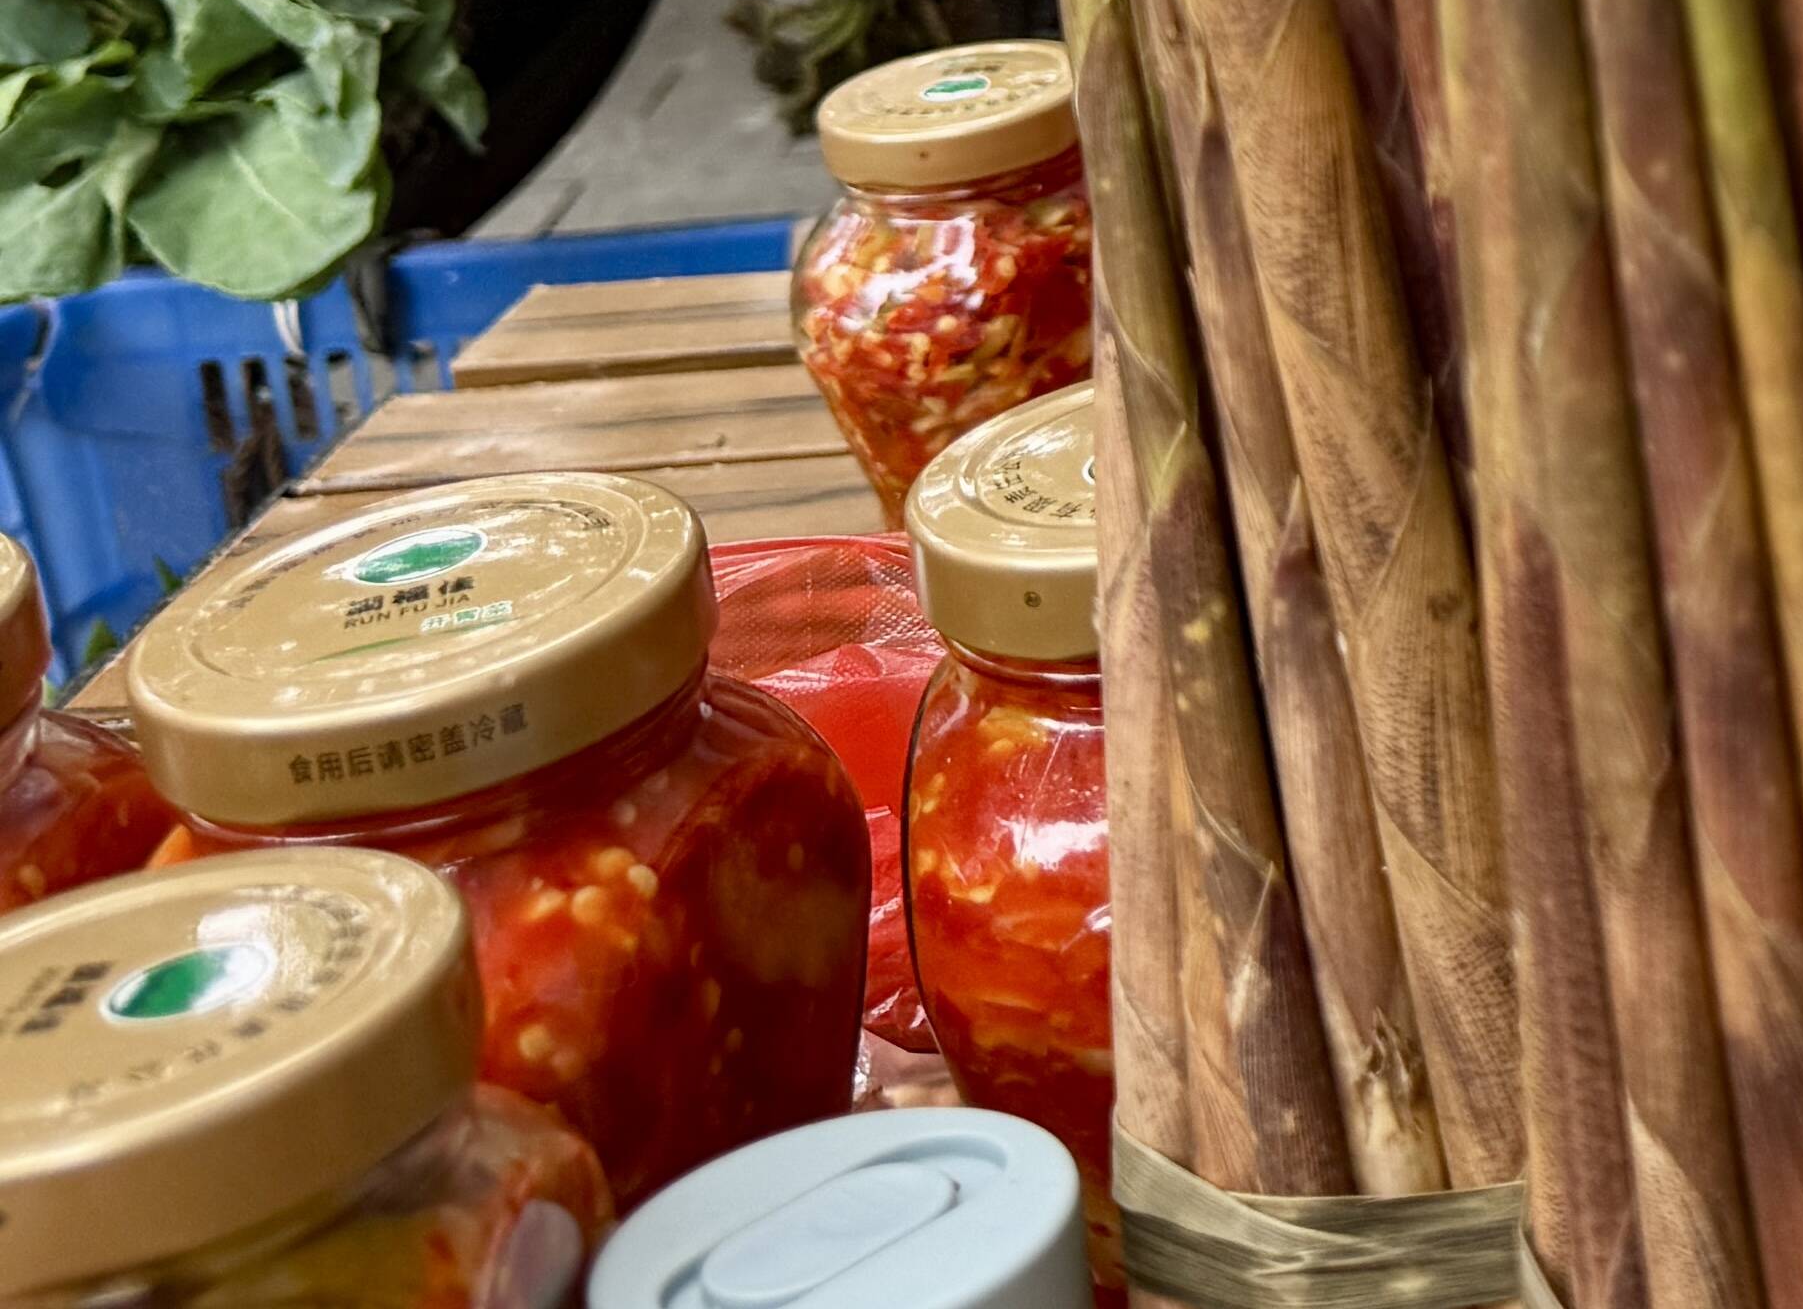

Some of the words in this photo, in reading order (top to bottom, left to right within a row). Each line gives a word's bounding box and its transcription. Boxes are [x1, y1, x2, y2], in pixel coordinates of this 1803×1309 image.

[343, 611, 391, 630] RUN
[399, 602, 428, 618] FU
[434, 593, 471, 608] JIA
[288, 702, 529, 785] 食用后请密盖冷藏
